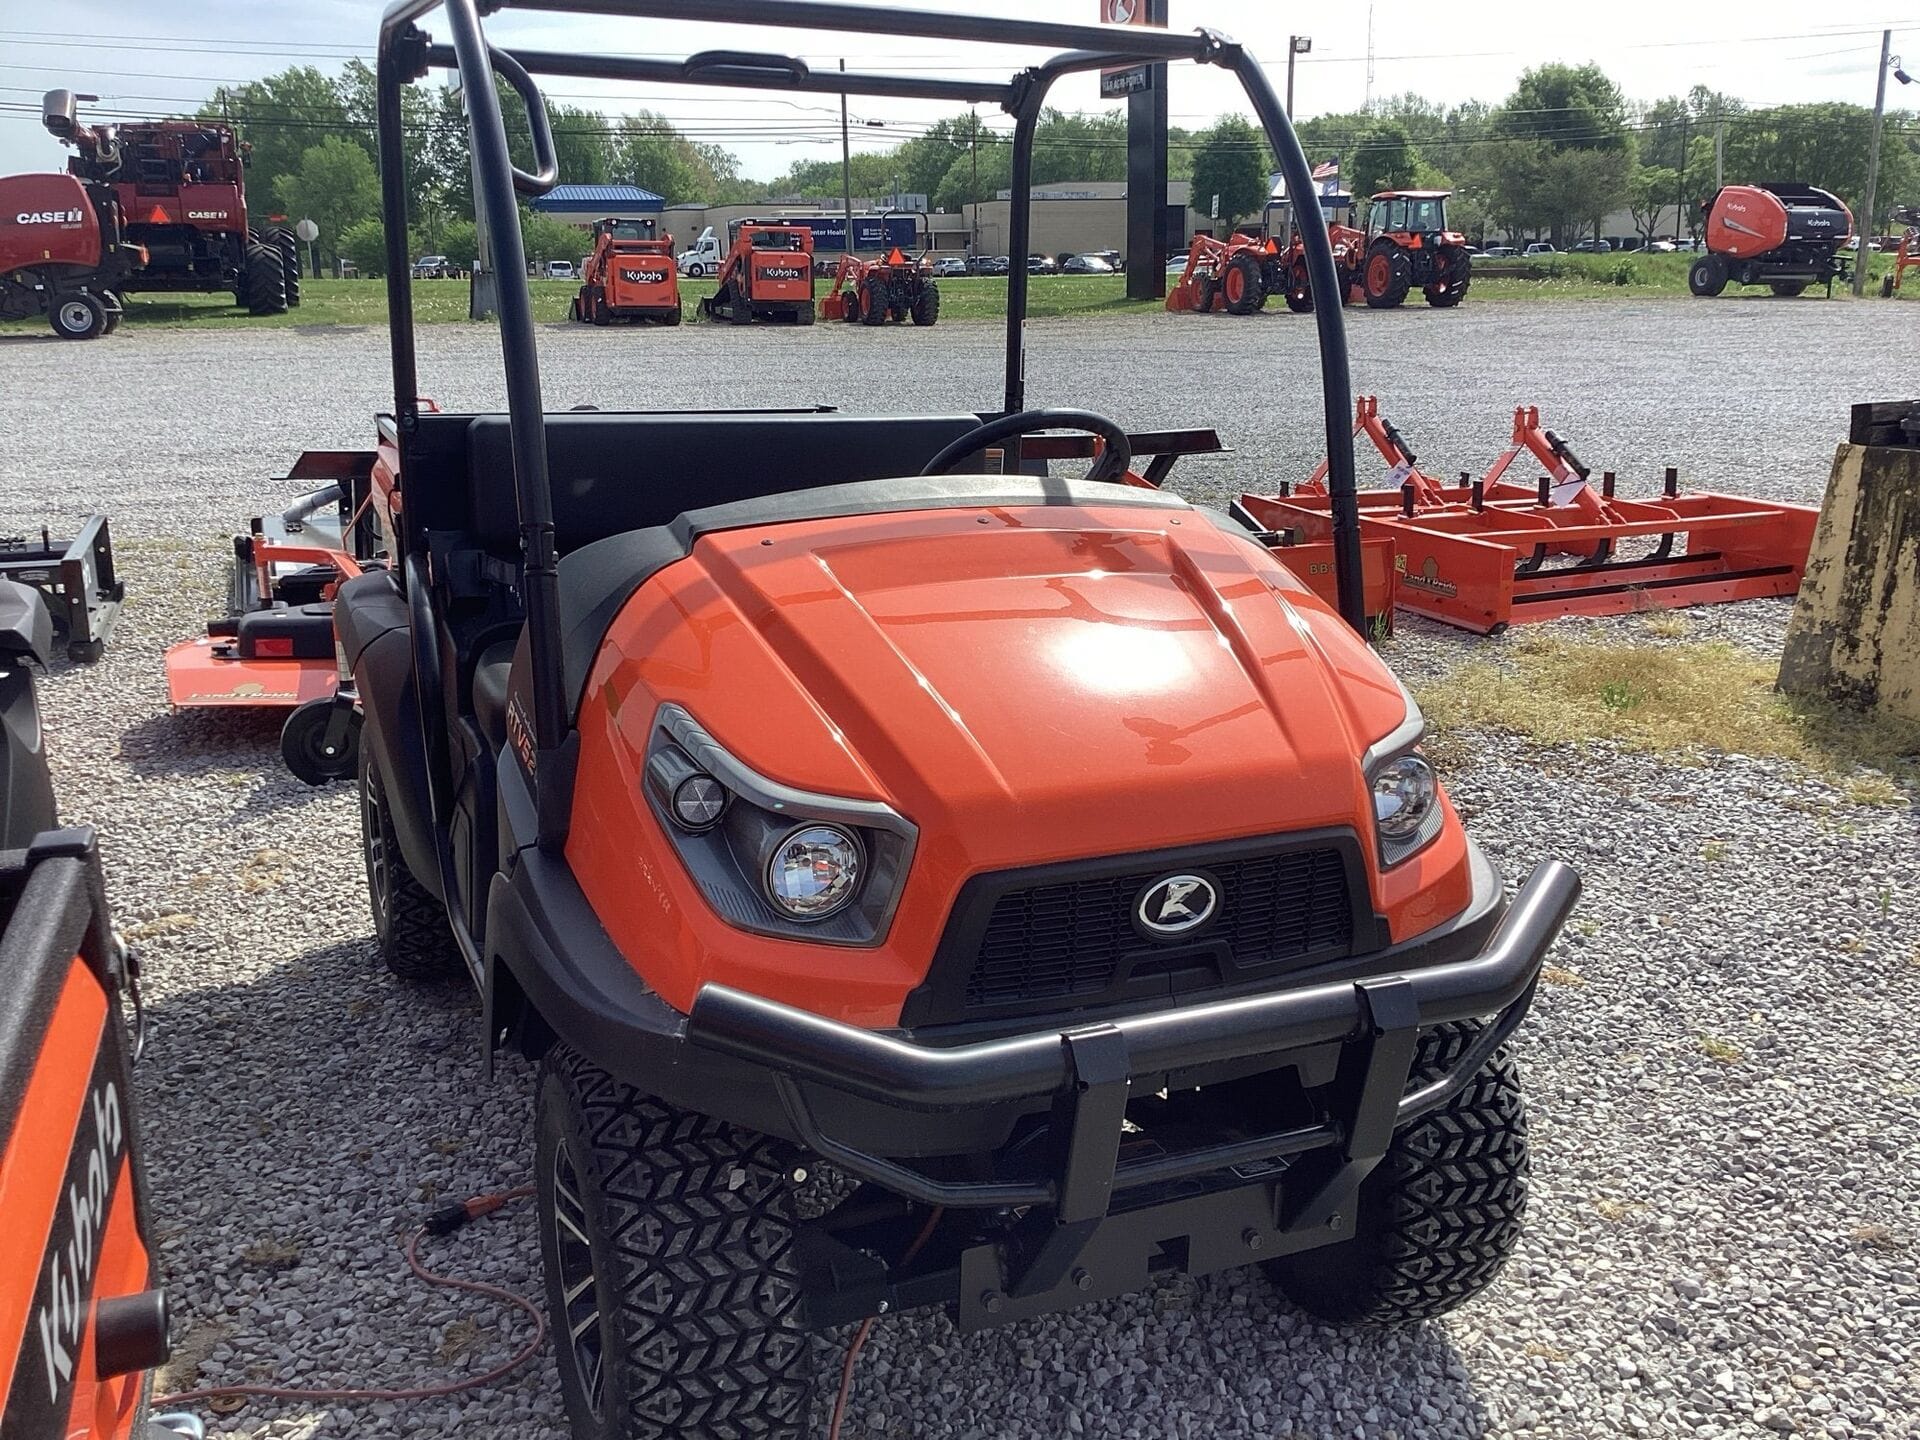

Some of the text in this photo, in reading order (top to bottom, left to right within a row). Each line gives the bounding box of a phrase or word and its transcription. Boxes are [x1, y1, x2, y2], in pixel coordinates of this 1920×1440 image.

[1727, 203, 1747, 213] Kubota
[16, 211, 66, 225] CASE
[188, 211, 217, 219] CASE
[1807, 219, 1831, 227] Kubota
[627, 271, 663, 281] Kubota
[767, 268, 799, 278] Kubota
[39, 1082, 122, 1405] Kubota
